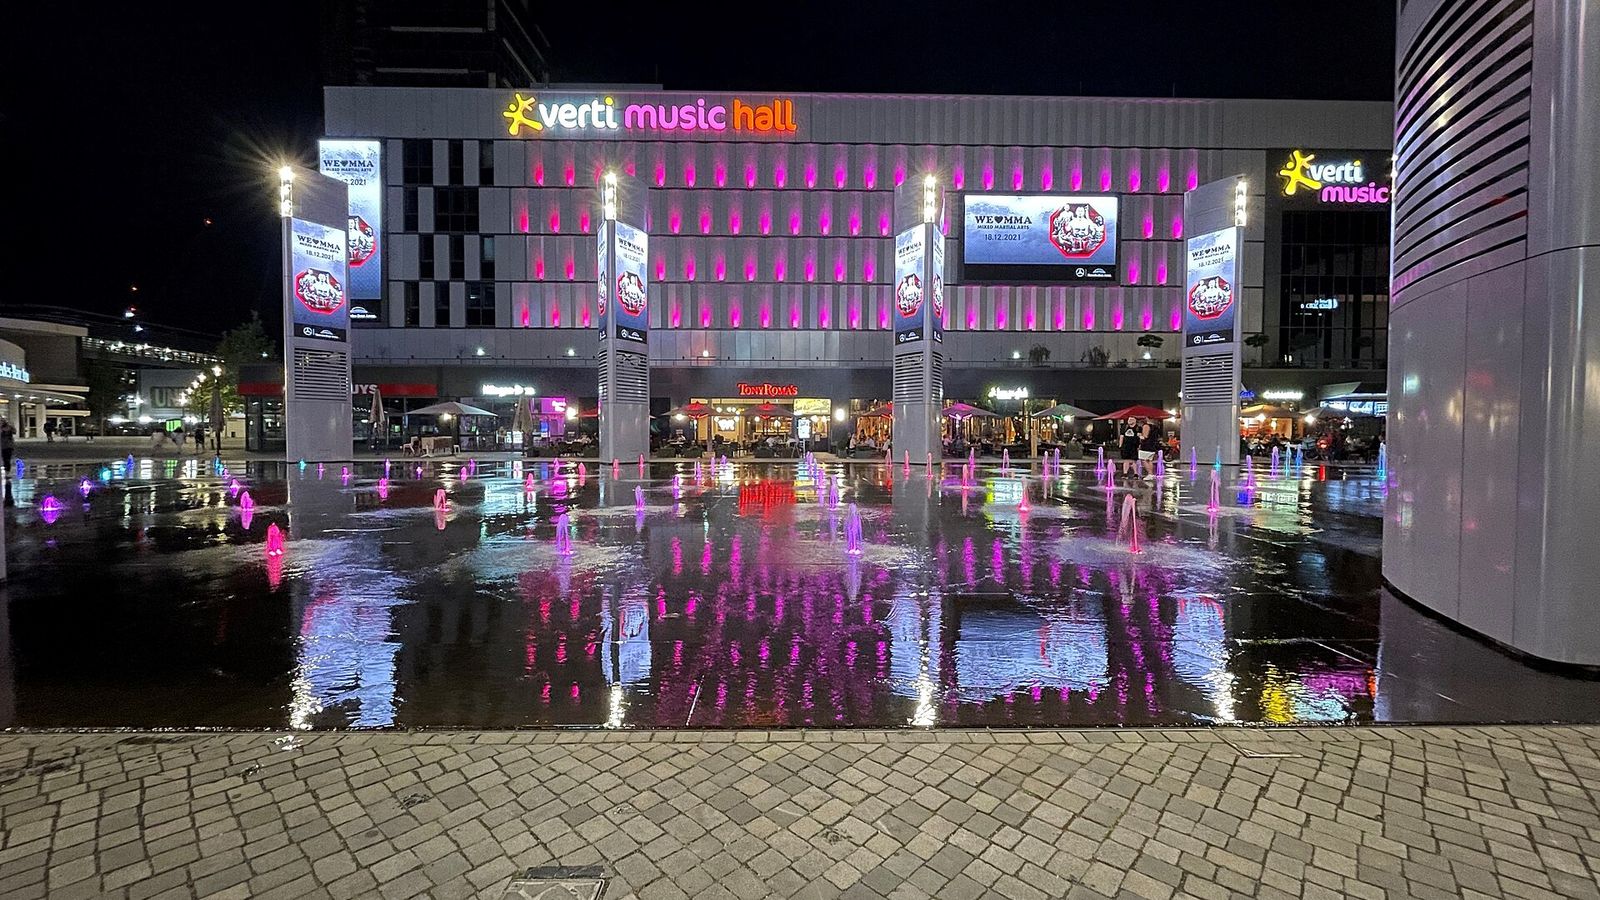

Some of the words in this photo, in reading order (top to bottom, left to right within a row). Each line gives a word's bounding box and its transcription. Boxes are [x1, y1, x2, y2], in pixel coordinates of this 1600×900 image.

[538, 96, 618, 130] verti
[624, 98, 726, 131] music
[733, 99, 797, 131] hall
[1310, 160, 1363, 182] verti
[1321, 182, 1389, 203] music
[975, 216, 994, 224] WE
[1004, 216, 1032, 224] MMA
